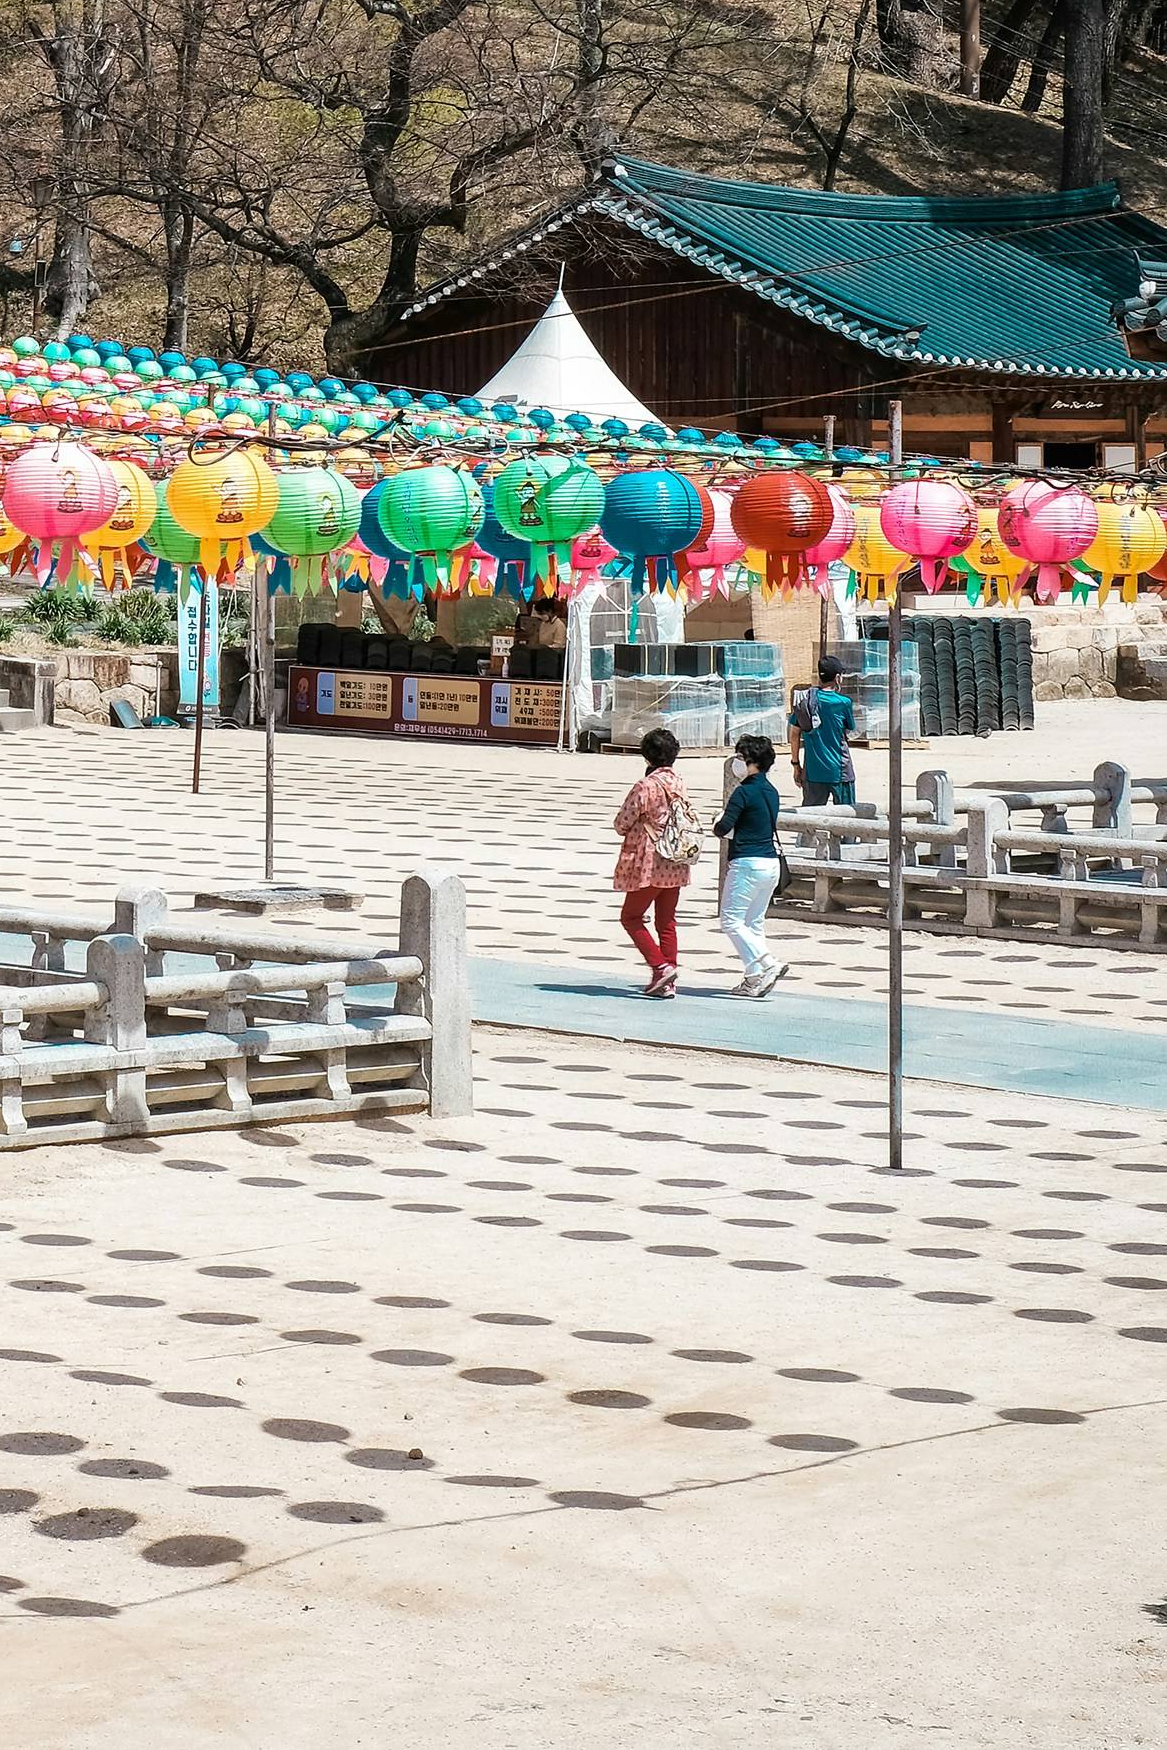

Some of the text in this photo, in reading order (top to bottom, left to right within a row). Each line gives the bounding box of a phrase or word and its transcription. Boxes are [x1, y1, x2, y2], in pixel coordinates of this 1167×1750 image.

[187, 606, 198, 672] 접수합니다
[321, 690, 333, 698] 기도
[546, 688, 563, 698] 50만
